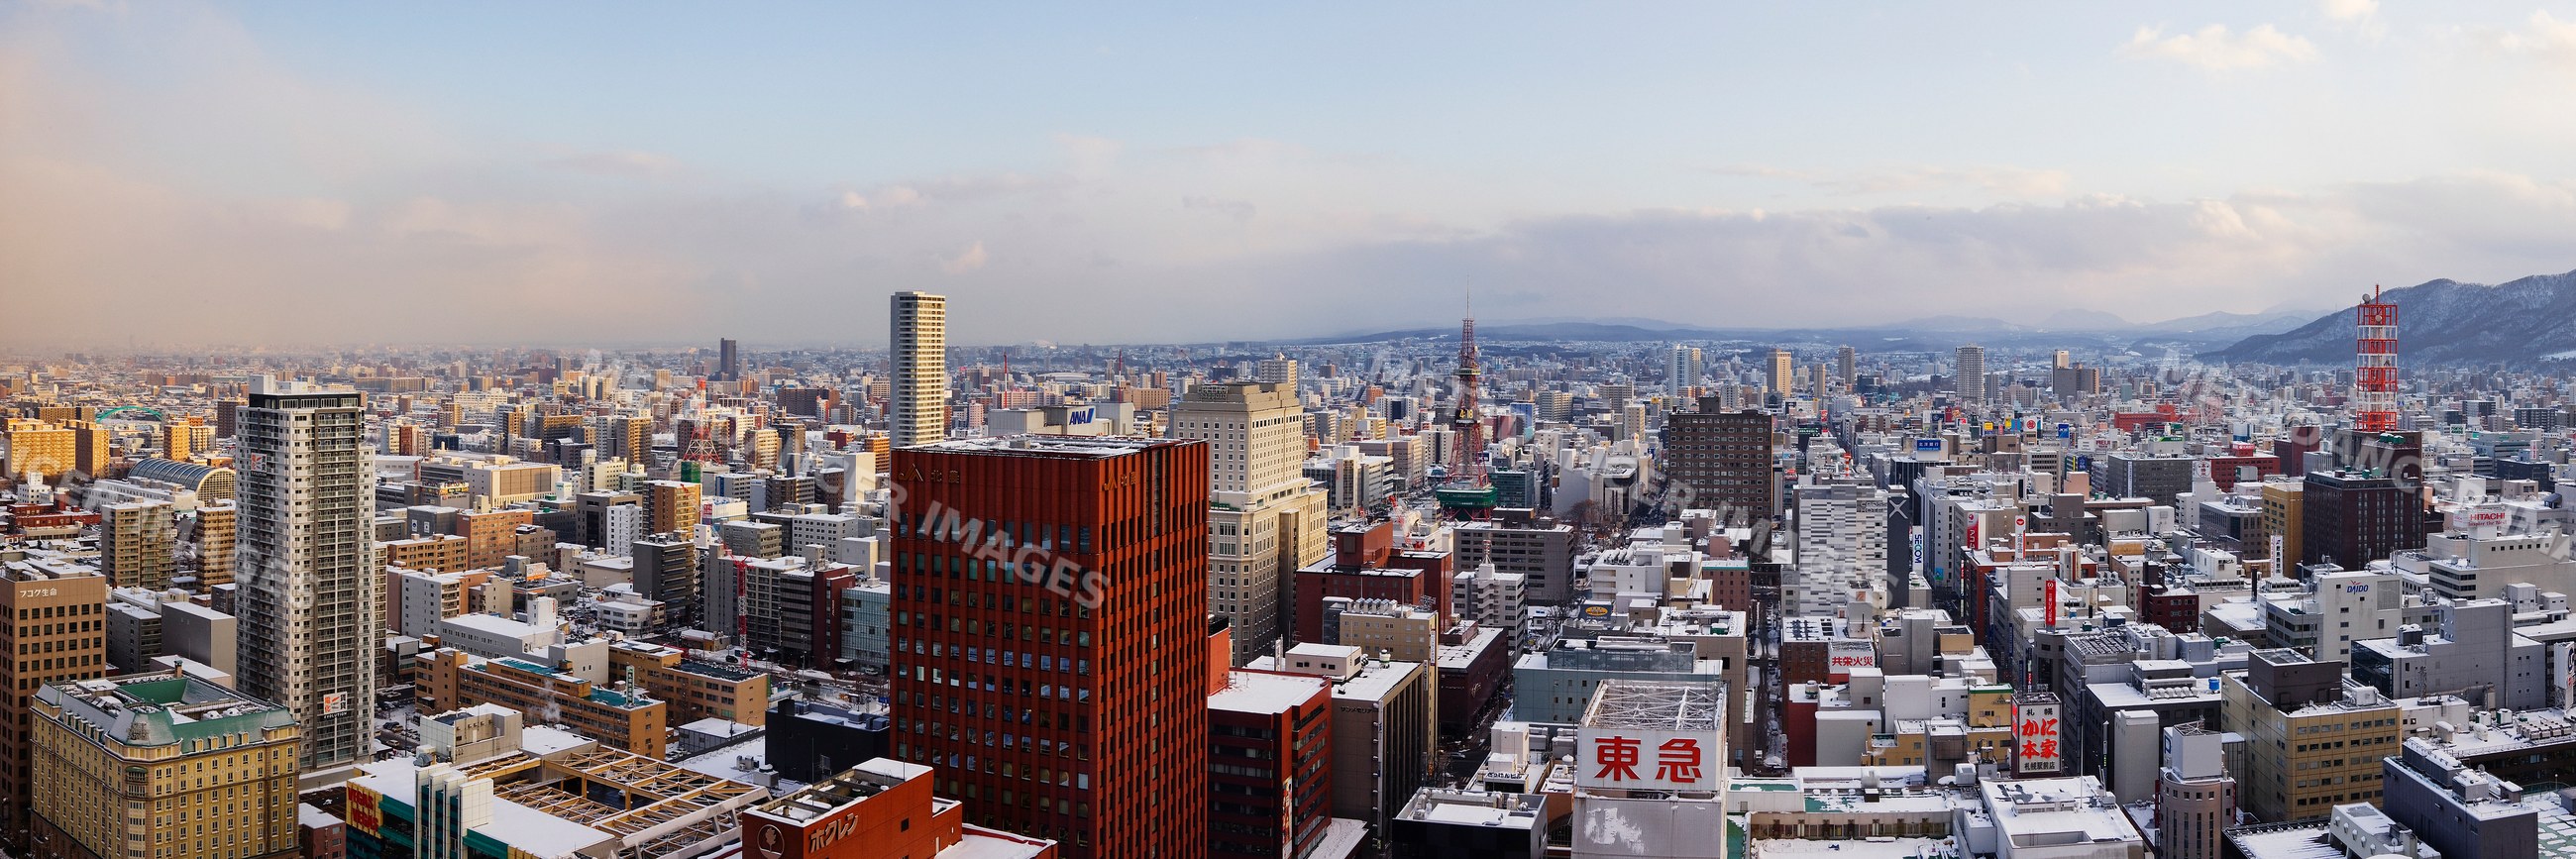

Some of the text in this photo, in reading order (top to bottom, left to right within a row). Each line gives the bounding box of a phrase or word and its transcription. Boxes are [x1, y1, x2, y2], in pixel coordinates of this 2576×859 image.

[1069, 410, 1087, 426] ANA
[1459, 408, 1474, 419] 4:18
[2470, 512, 2506, 521] HITACHI
[20, 588, 57, 598] フコク生命
[2347, 585, 2369, 593] DAIDO
[1832, 656, 1873, 667] 共栄火災
[1341, 705, 1373, 714] サンメモリア
[2026, 707, 2053, 716] 札幌
[2021, 717, 2059, 737] かに
[2019, 738, 2059, 759] 本家
[1594, 735, 1702, 785] 東急
[2024, 761, 2056, 771] 札幌駅前店
[348, 787, 375, 810] VEGAS
[351, 807, 378, 833] VEGAS
[809, 812, 859, 854] ホクレン
